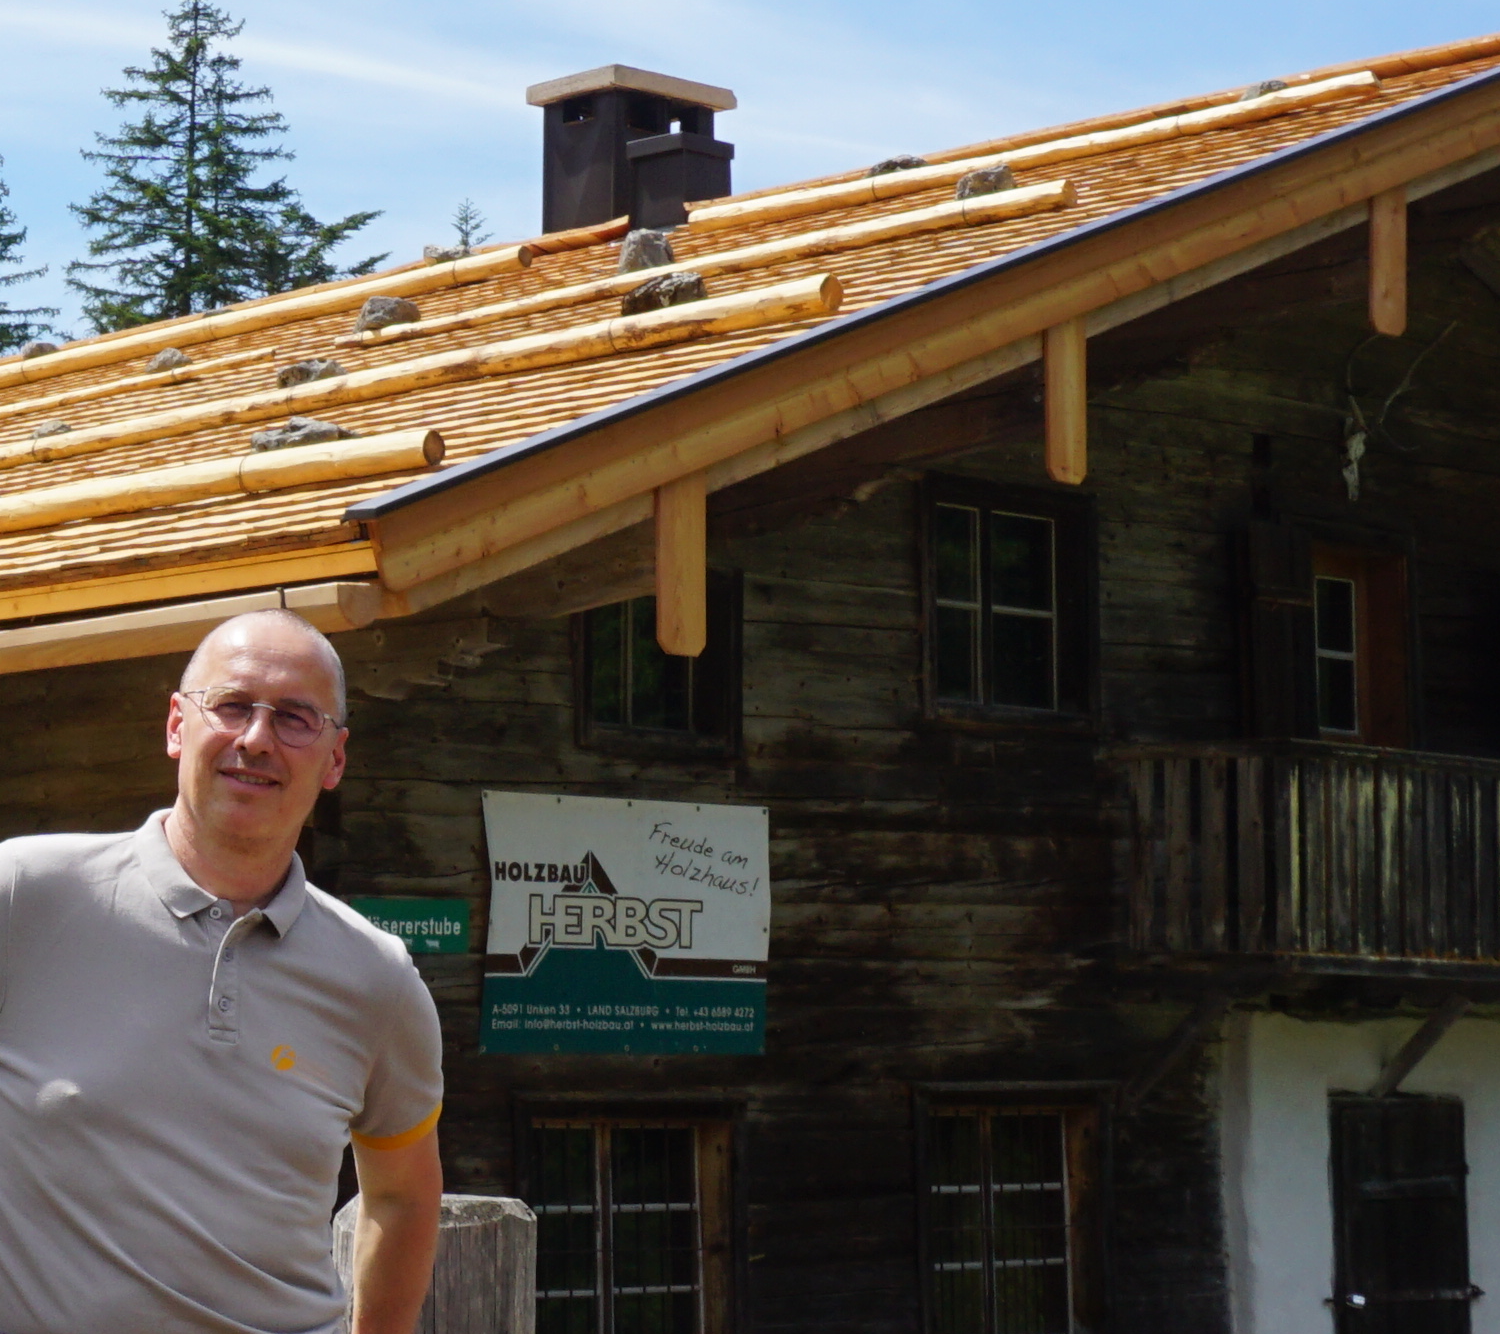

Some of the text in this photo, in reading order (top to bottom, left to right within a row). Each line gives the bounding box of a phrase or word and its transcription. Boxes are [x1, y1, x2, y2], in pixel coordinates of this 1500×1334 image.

[649, 822, 749, 869] Freude am
[494, 861, 585, 884] HOLZBAU
[655, 851, 760, 897] Holzhaus!
[367, 916, 461, 935] ösererstube
[529, 894, 704, 949] HERBST
[492, 1004, 523, 1015] A-5091
[526, 1004, 557, 1015] Unken
[587, 1005, 612, 1016] LAND
[614, 1005, 660, 1017] SALZBURG
